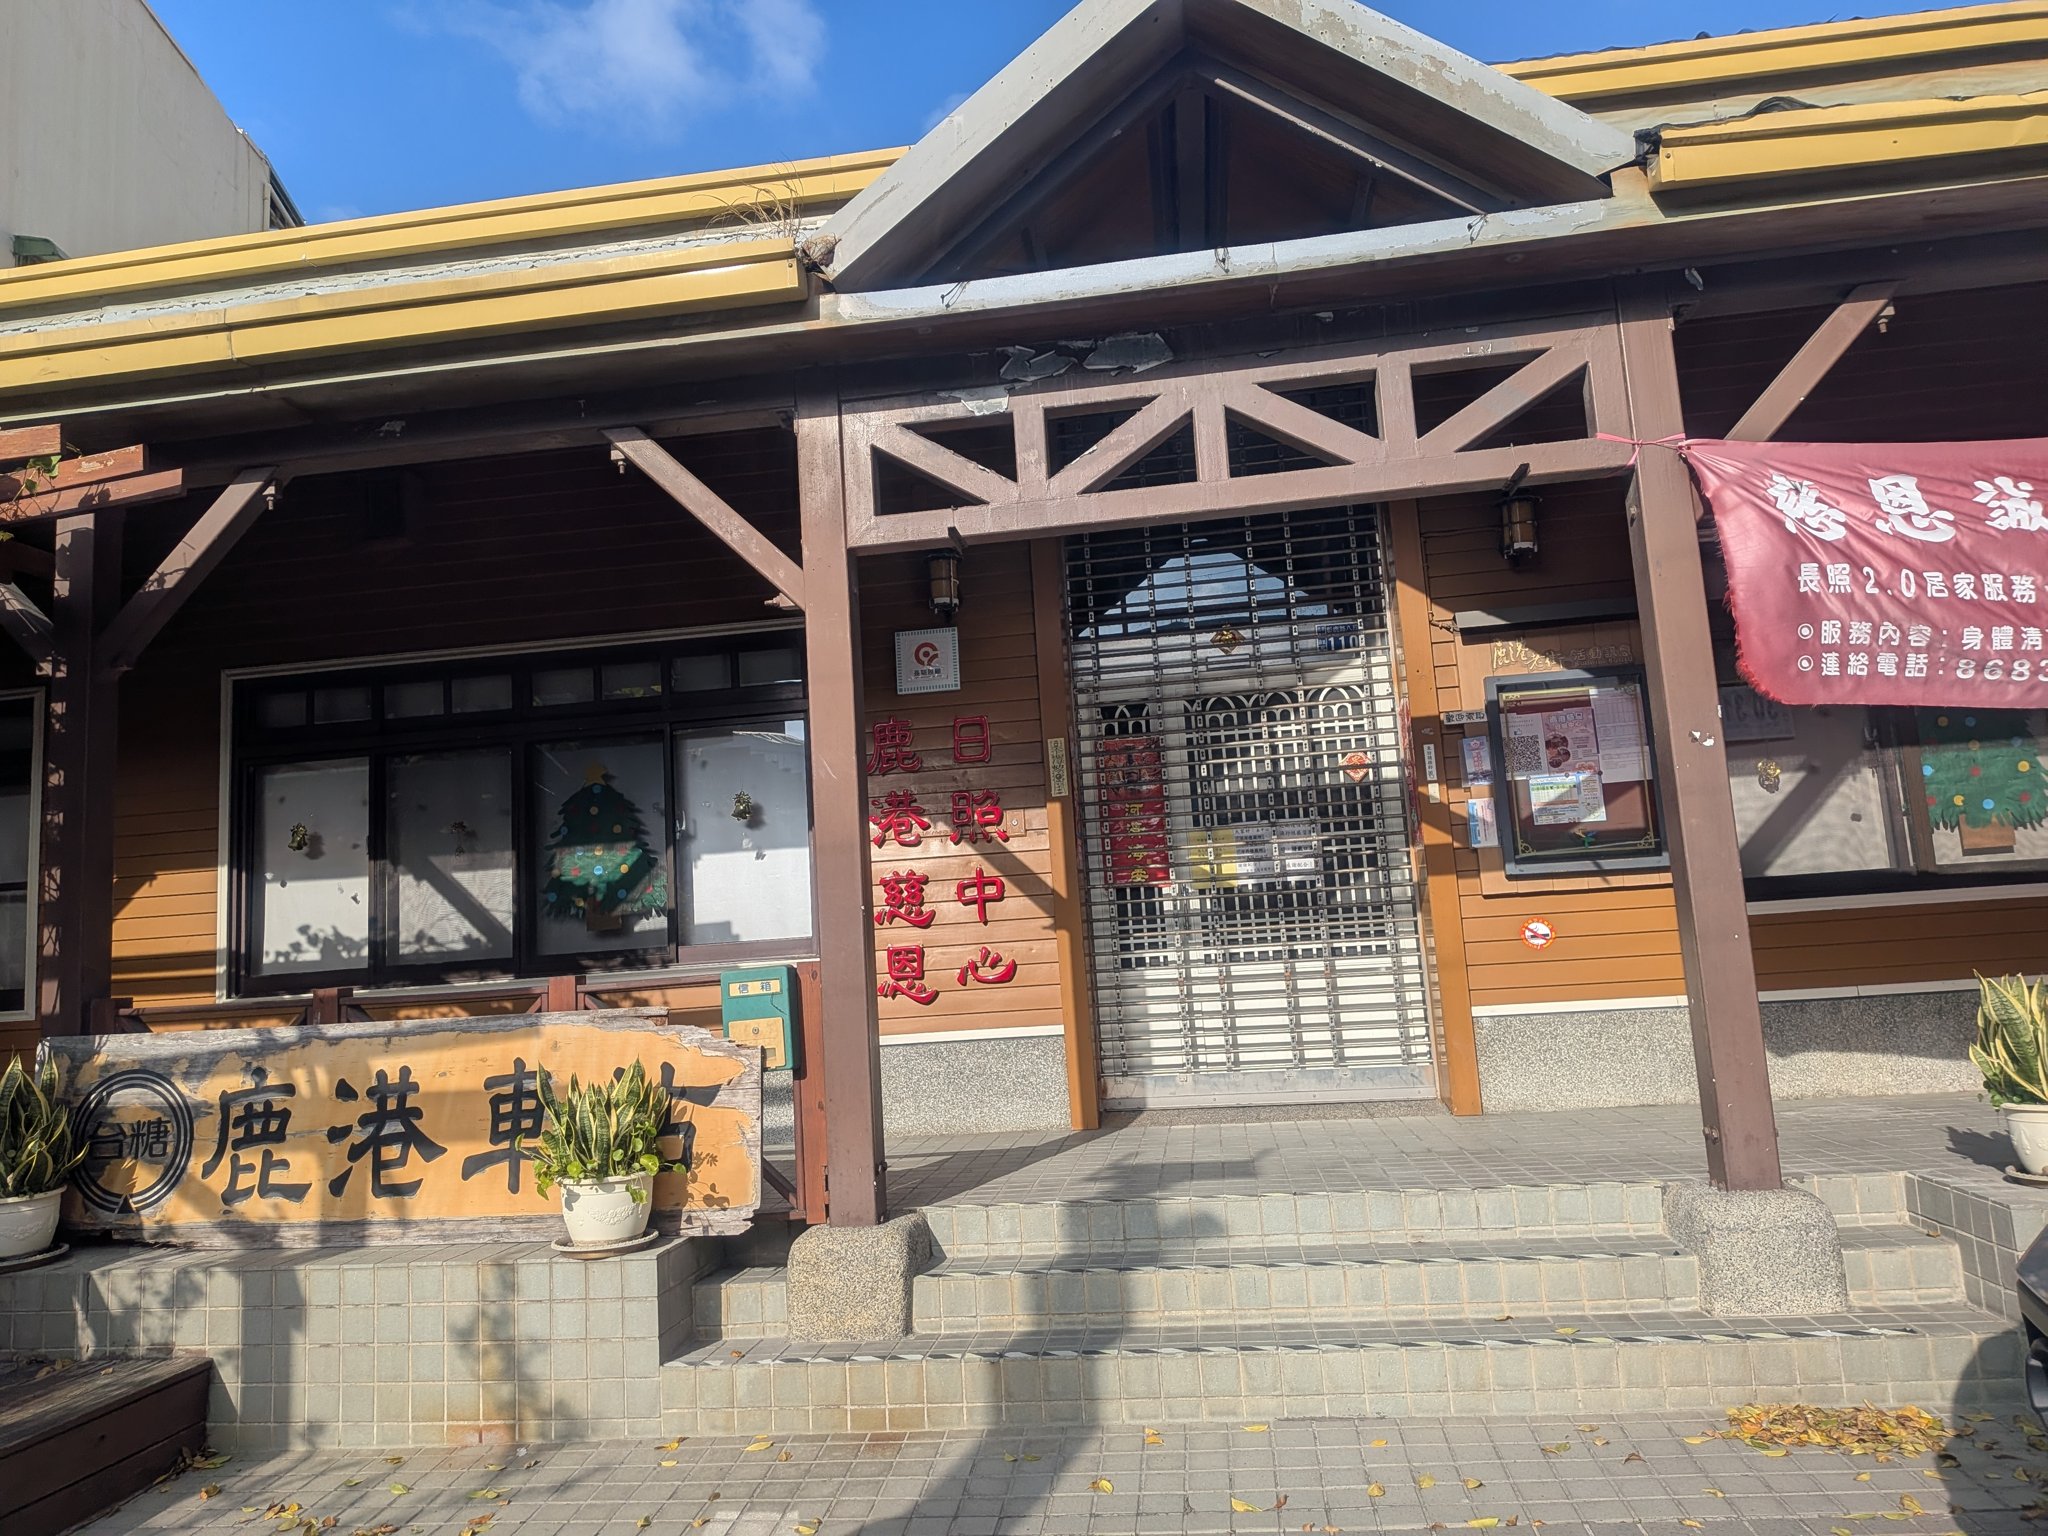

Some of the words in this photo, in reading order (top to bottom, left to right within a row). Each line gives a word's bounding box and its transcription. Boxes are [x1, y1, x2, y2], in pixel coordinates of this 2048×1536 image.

[1797, 562, 2048, 604] 長照2.0居家服務
[1820, 620, 2048, 651] 服務內容：身體清
[866, 714, 940, 1007] 鹿港慈恩
[949, 714, 1018, 988] 日照中心
[738, 981, 772, 994] 信箱
[87, 1117, 172, 1160] 台糖
